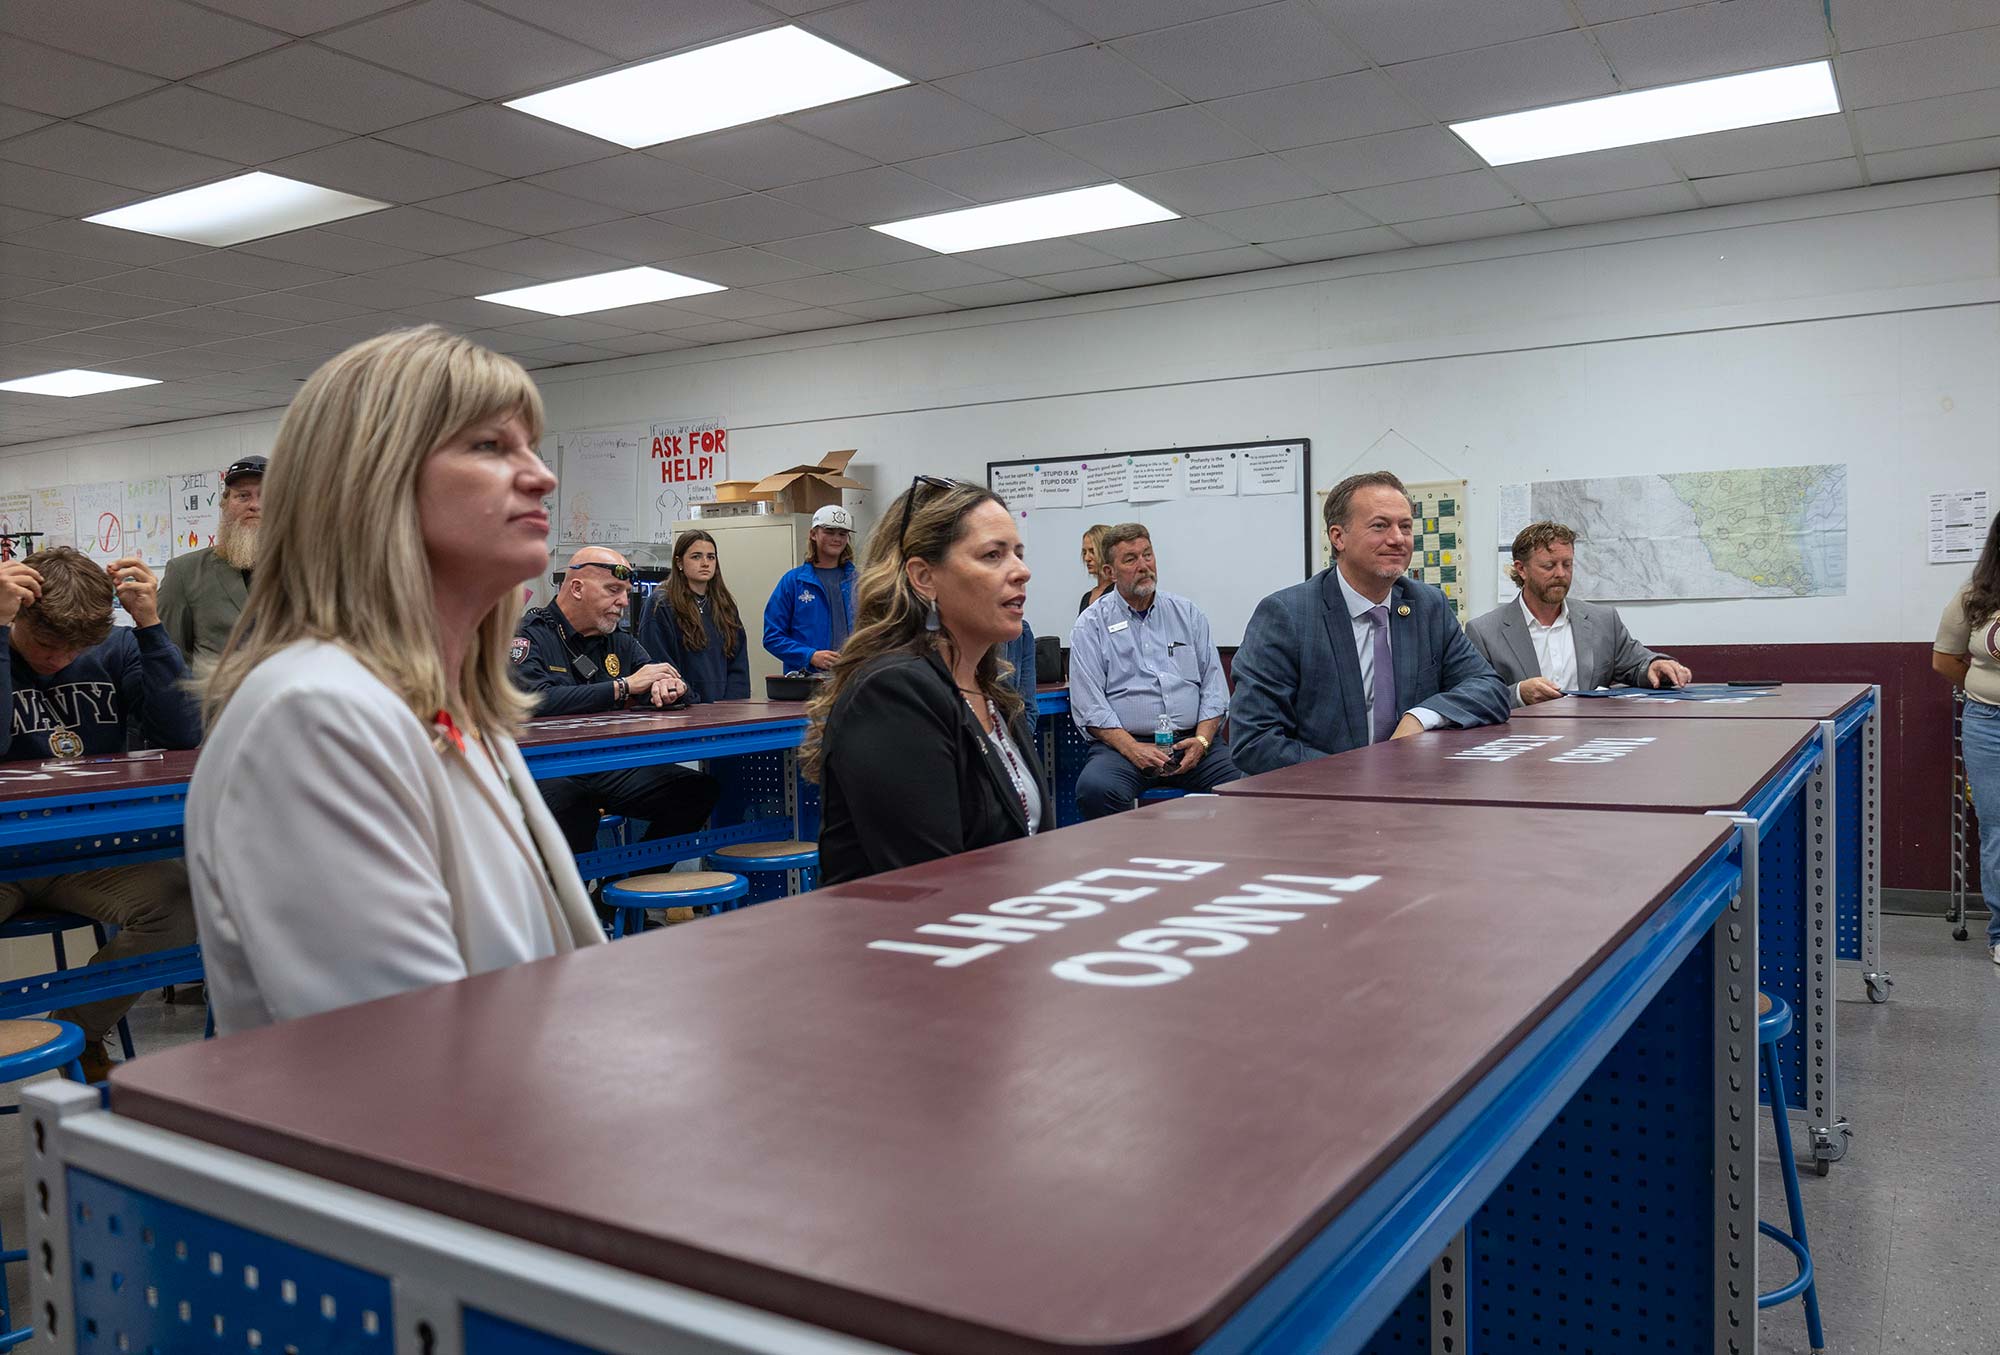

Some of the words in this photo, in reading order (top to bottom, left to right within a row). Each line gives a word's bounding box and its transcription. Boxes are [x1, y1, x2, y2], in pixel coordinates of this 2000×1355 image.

[652, 436, 682, 458] ASK
[689, 429, 726, 454] FOR
[658, 428, 674, 440] you
[662, 456, 713, 483] HELP!
[128, 478, 168, 498] SAFETY
[11, 681, 118, 736] NAVY
[1444, 735, 1564, 762] FLIGHT
[1547, 737, 1658, 764] TANGO
[867, 857, 1227, 967] FLIGHT
[1048, 874, 1383, 988] TANGO
